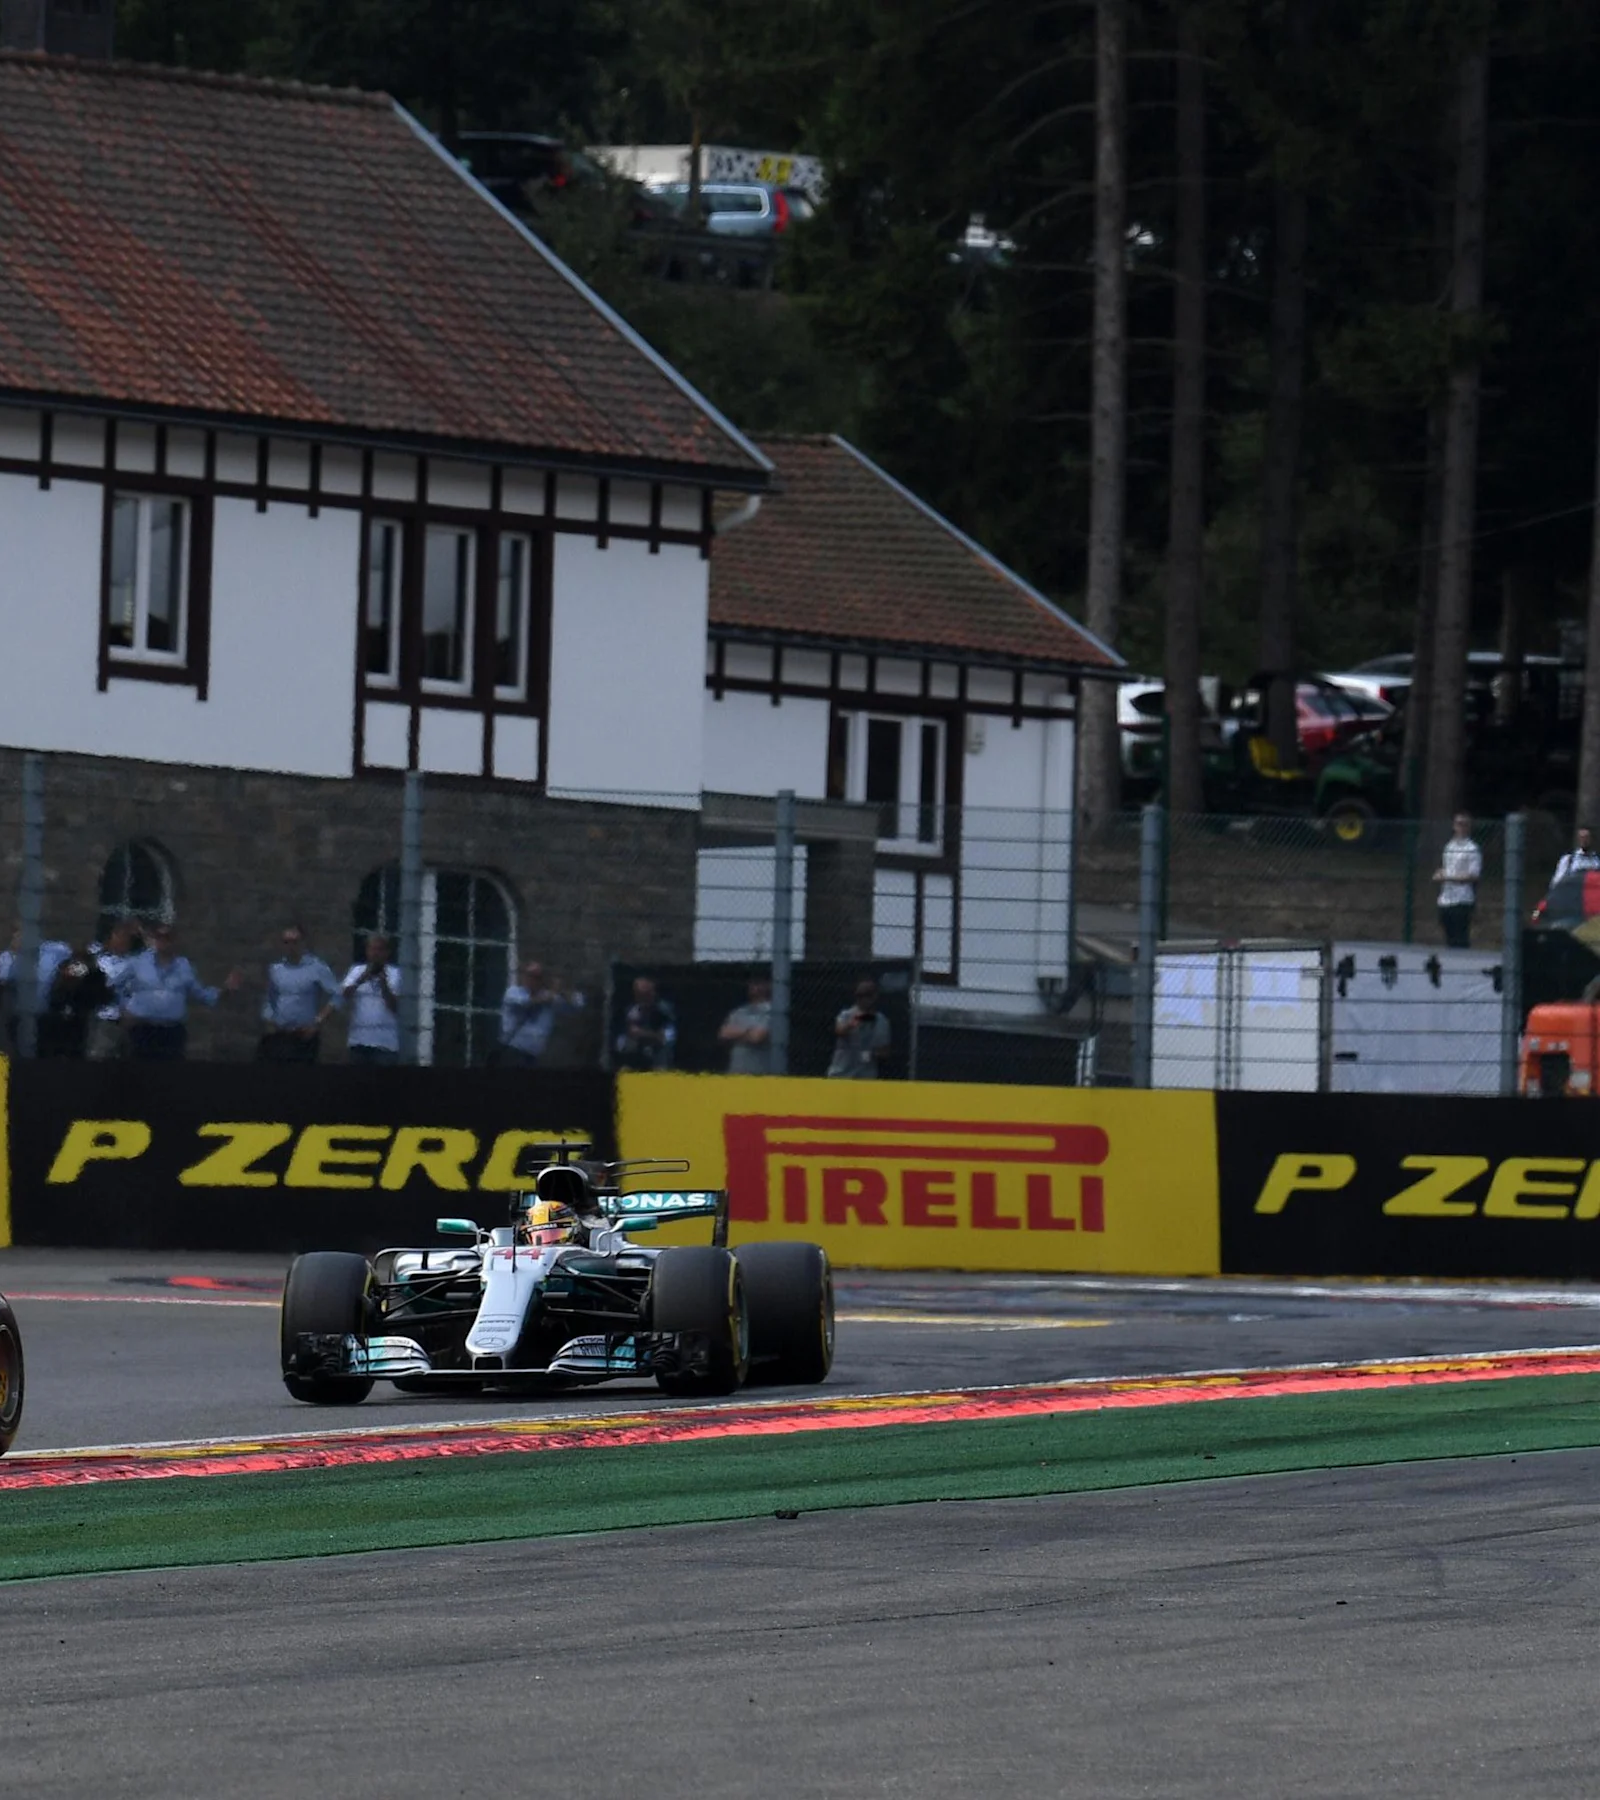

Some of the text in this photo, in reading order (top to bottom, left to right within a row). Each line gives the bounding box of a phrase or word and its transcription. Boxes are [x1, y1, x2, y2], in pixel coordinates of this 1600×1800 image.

[46, 1120, 151, 1185] P
[723, 1113, 1109, 1233] PIRELLI
[1254, 1153, 1600, 1220] P ZE
